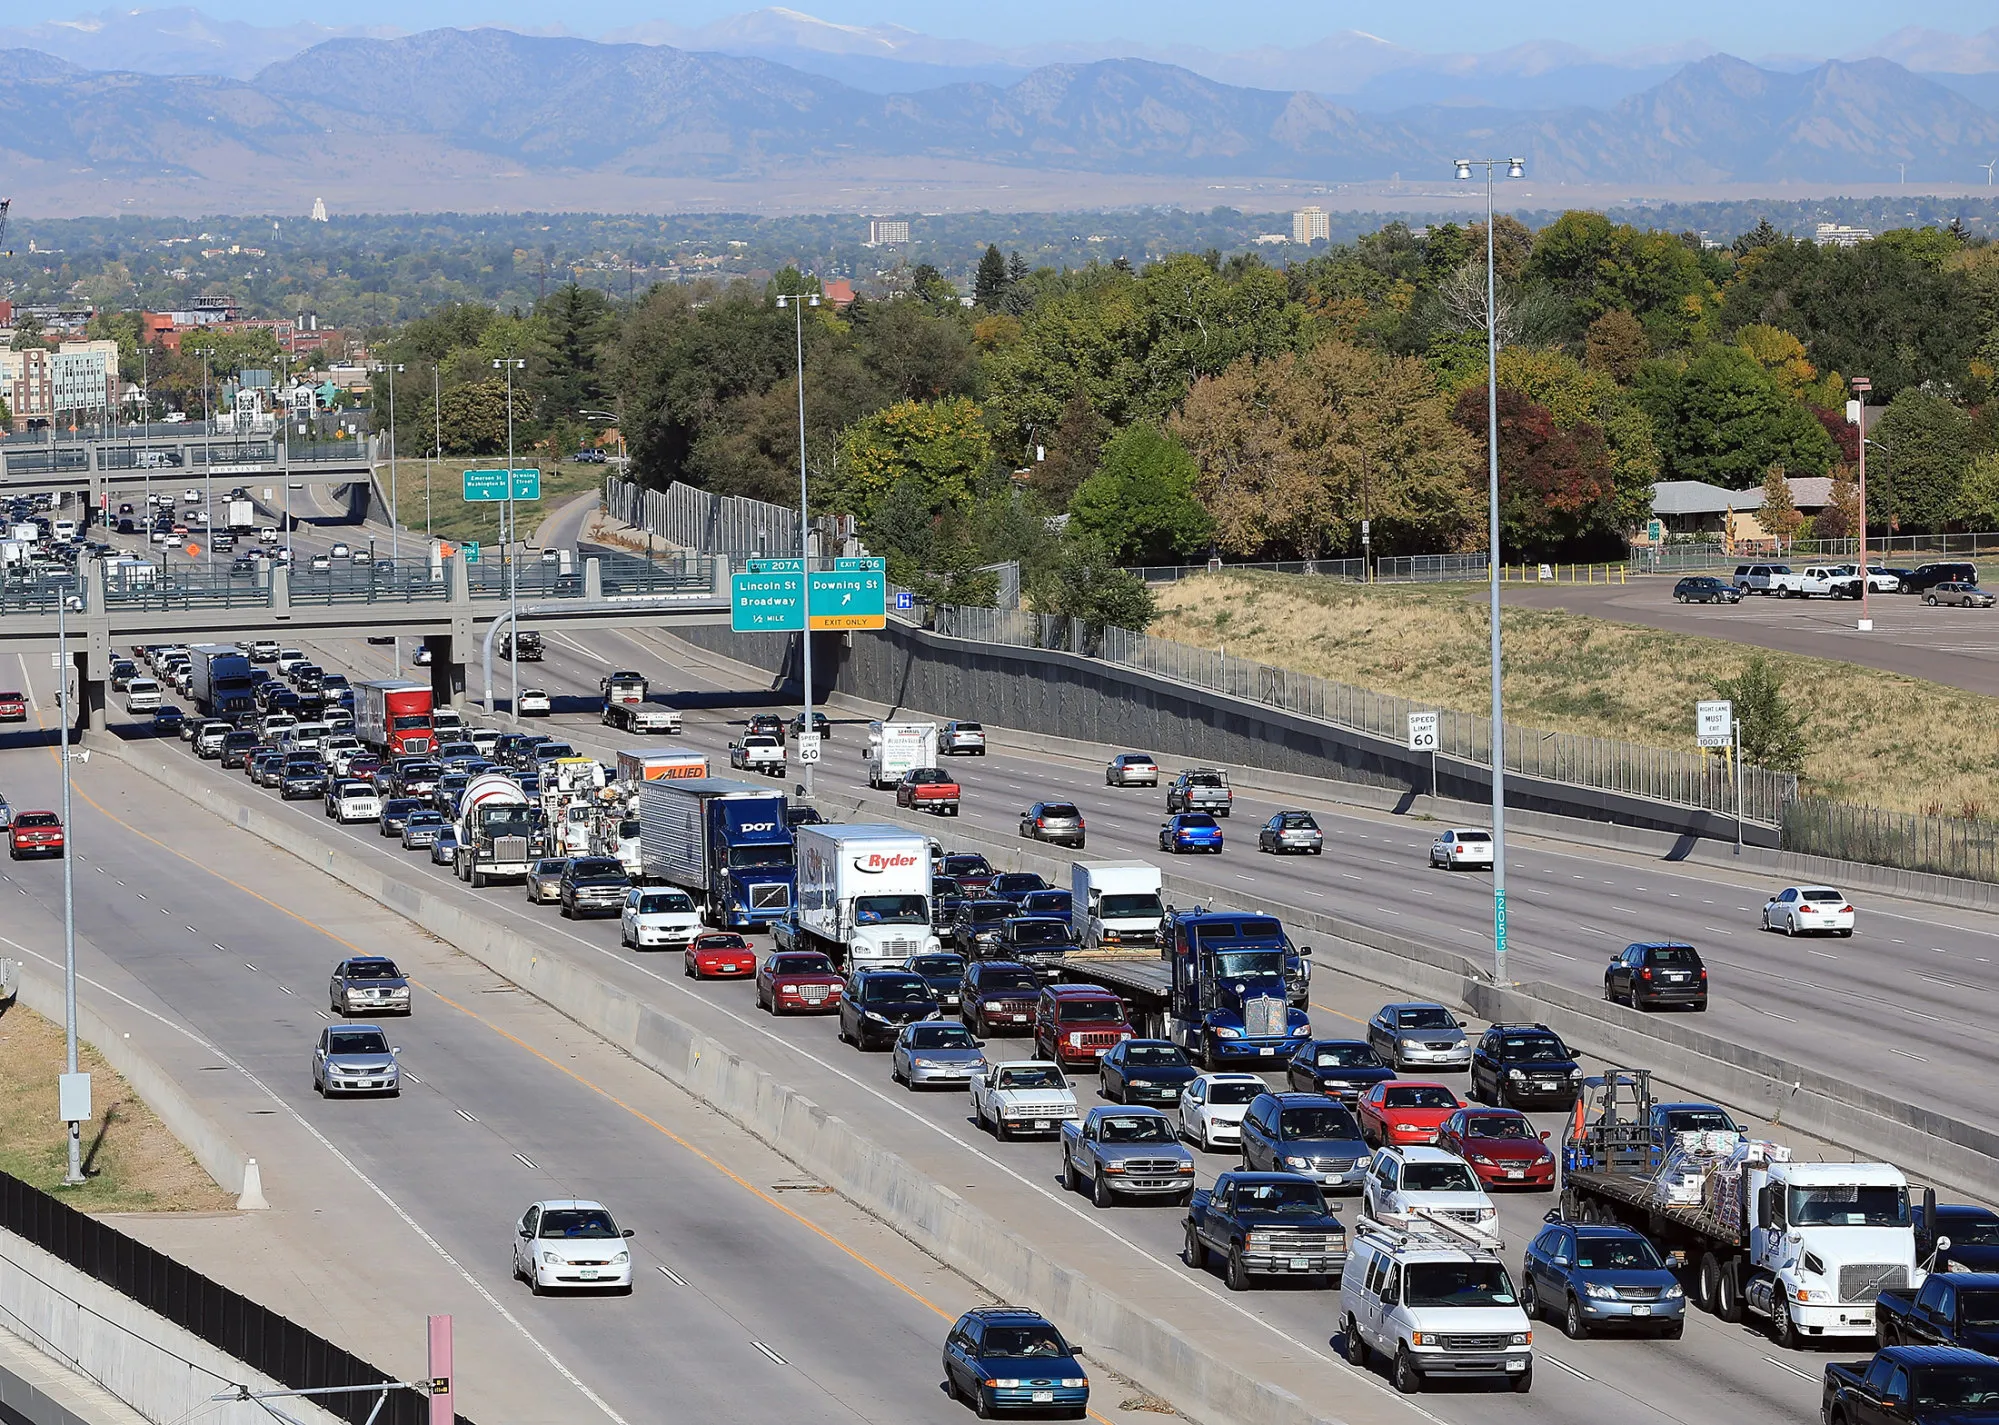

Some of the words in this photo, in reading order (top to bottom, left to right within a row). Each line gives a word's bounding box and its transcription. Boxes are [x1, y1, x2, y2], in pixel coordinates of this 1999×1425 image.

[771, 561, 801, 570] 207A
[859, 560, 880, 569] 206
[739, 581, 782, 591] Lincoln
[784, 581, 797, 590] St
[813, 580, 861, 591] Downing
[866, 579, 878, 589] St
[740, 597, 796, 607] Broadway
[1414, 734, 1434, 746] 60
[1700, 738, 1719, 746] 1000
[801, 749, 818, 760] 60
[665, 767, 703, 779] ALLIED
[740, 822, 776, 833] DOT
[868, 854, 918, 870] Ryder
[1498, 897, 1506, 936] 205
